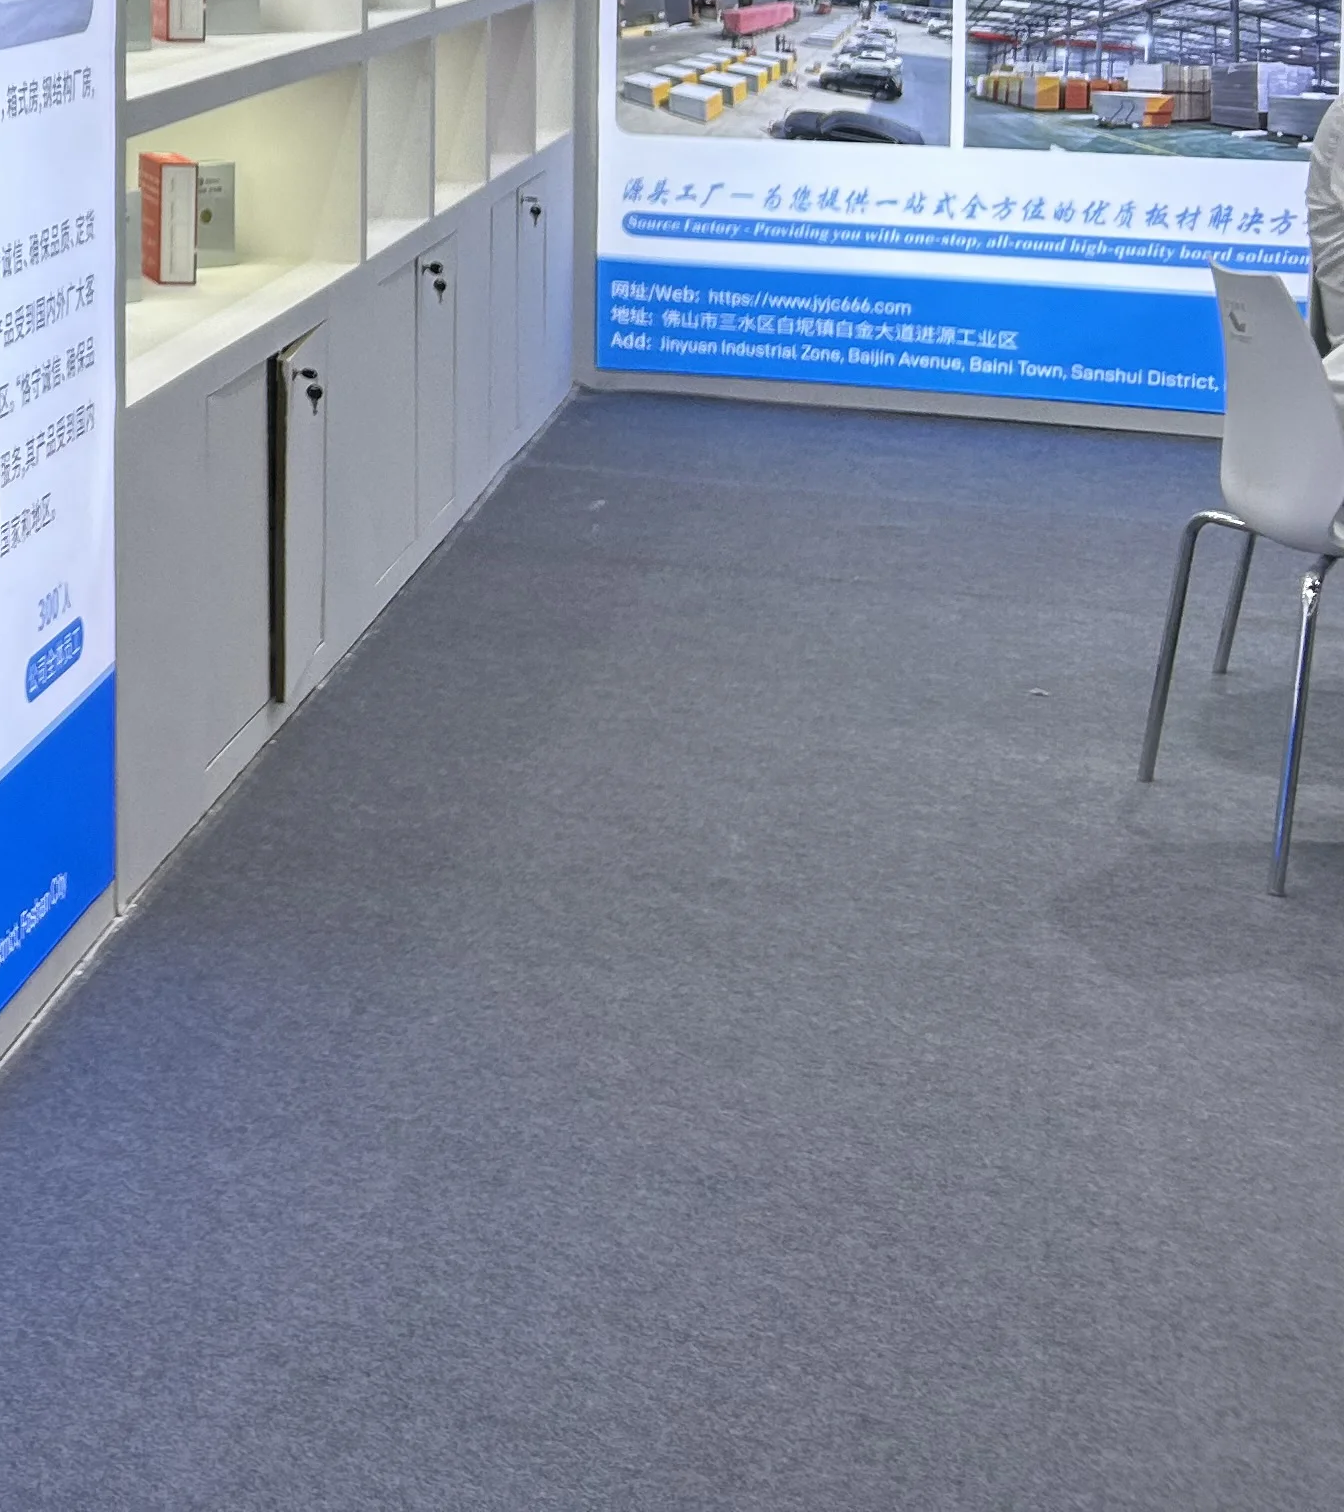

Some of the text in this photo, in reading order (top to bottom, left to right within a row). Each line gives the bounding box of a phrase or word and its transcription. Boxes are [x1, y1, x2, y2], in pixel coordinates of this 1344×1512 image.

[622, 176, 1310, 236] 源头工厂—为您提供一站式全方位的优质板材解决方
[683, 217, 741, 239] Factory
[753, 221, 830, 242] Providing
[830, 228, 861, 244] you
[864, 225, 901, 245] with
[985, 235, 1066, 254] all-round
[1069, 239, 1176, 262] high-quality
[721, 340, 798, 362] Industrial
[800, 344, 845, 365] Zone,
[897, 350, 966, 374] Avenue,
[1016, 358, 1067, 381] Town,
[1070, 361, 1143, 387] Sanshui
[1146, 367, 1220, 394] District,
